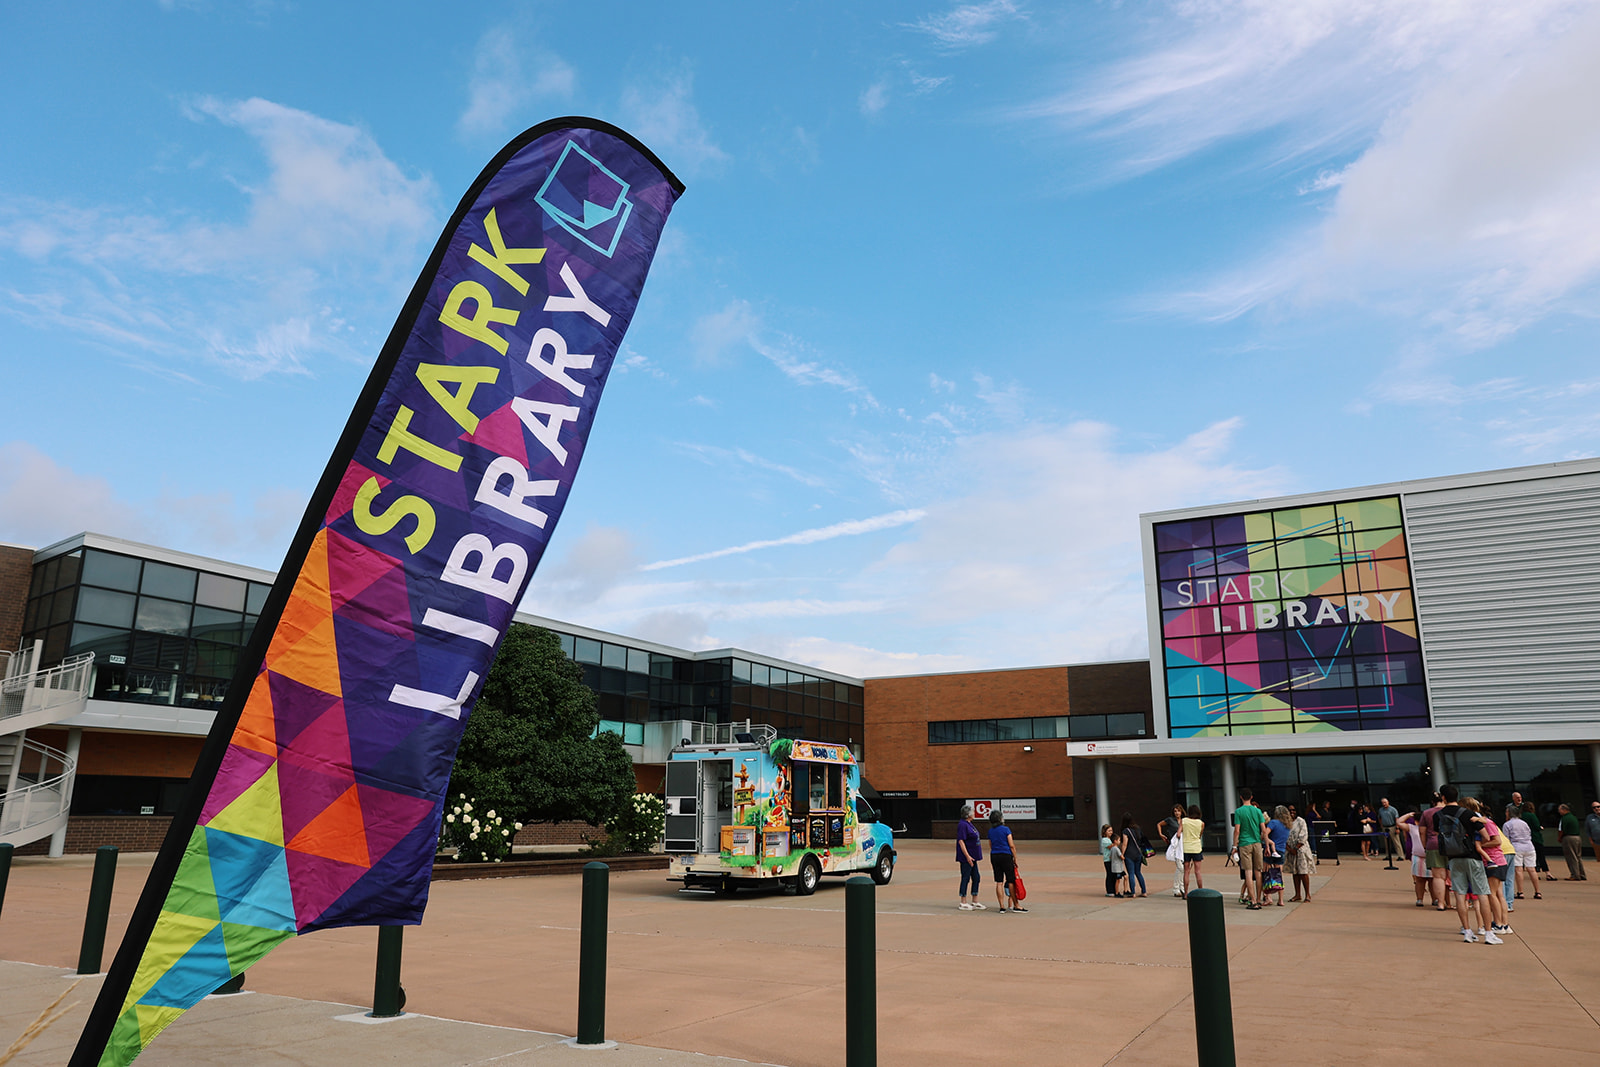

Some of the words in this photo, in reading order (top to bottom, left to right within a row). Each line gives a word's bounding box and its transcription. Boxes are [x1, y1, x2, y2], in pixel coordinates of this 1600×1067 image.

[352, 206, 548, 555] STARK
[388, 261, 612, 721] LIBRARY
[1177, 572, 1296, 606] STARK
[1212, 592, 1401, 633] LIBRARY
